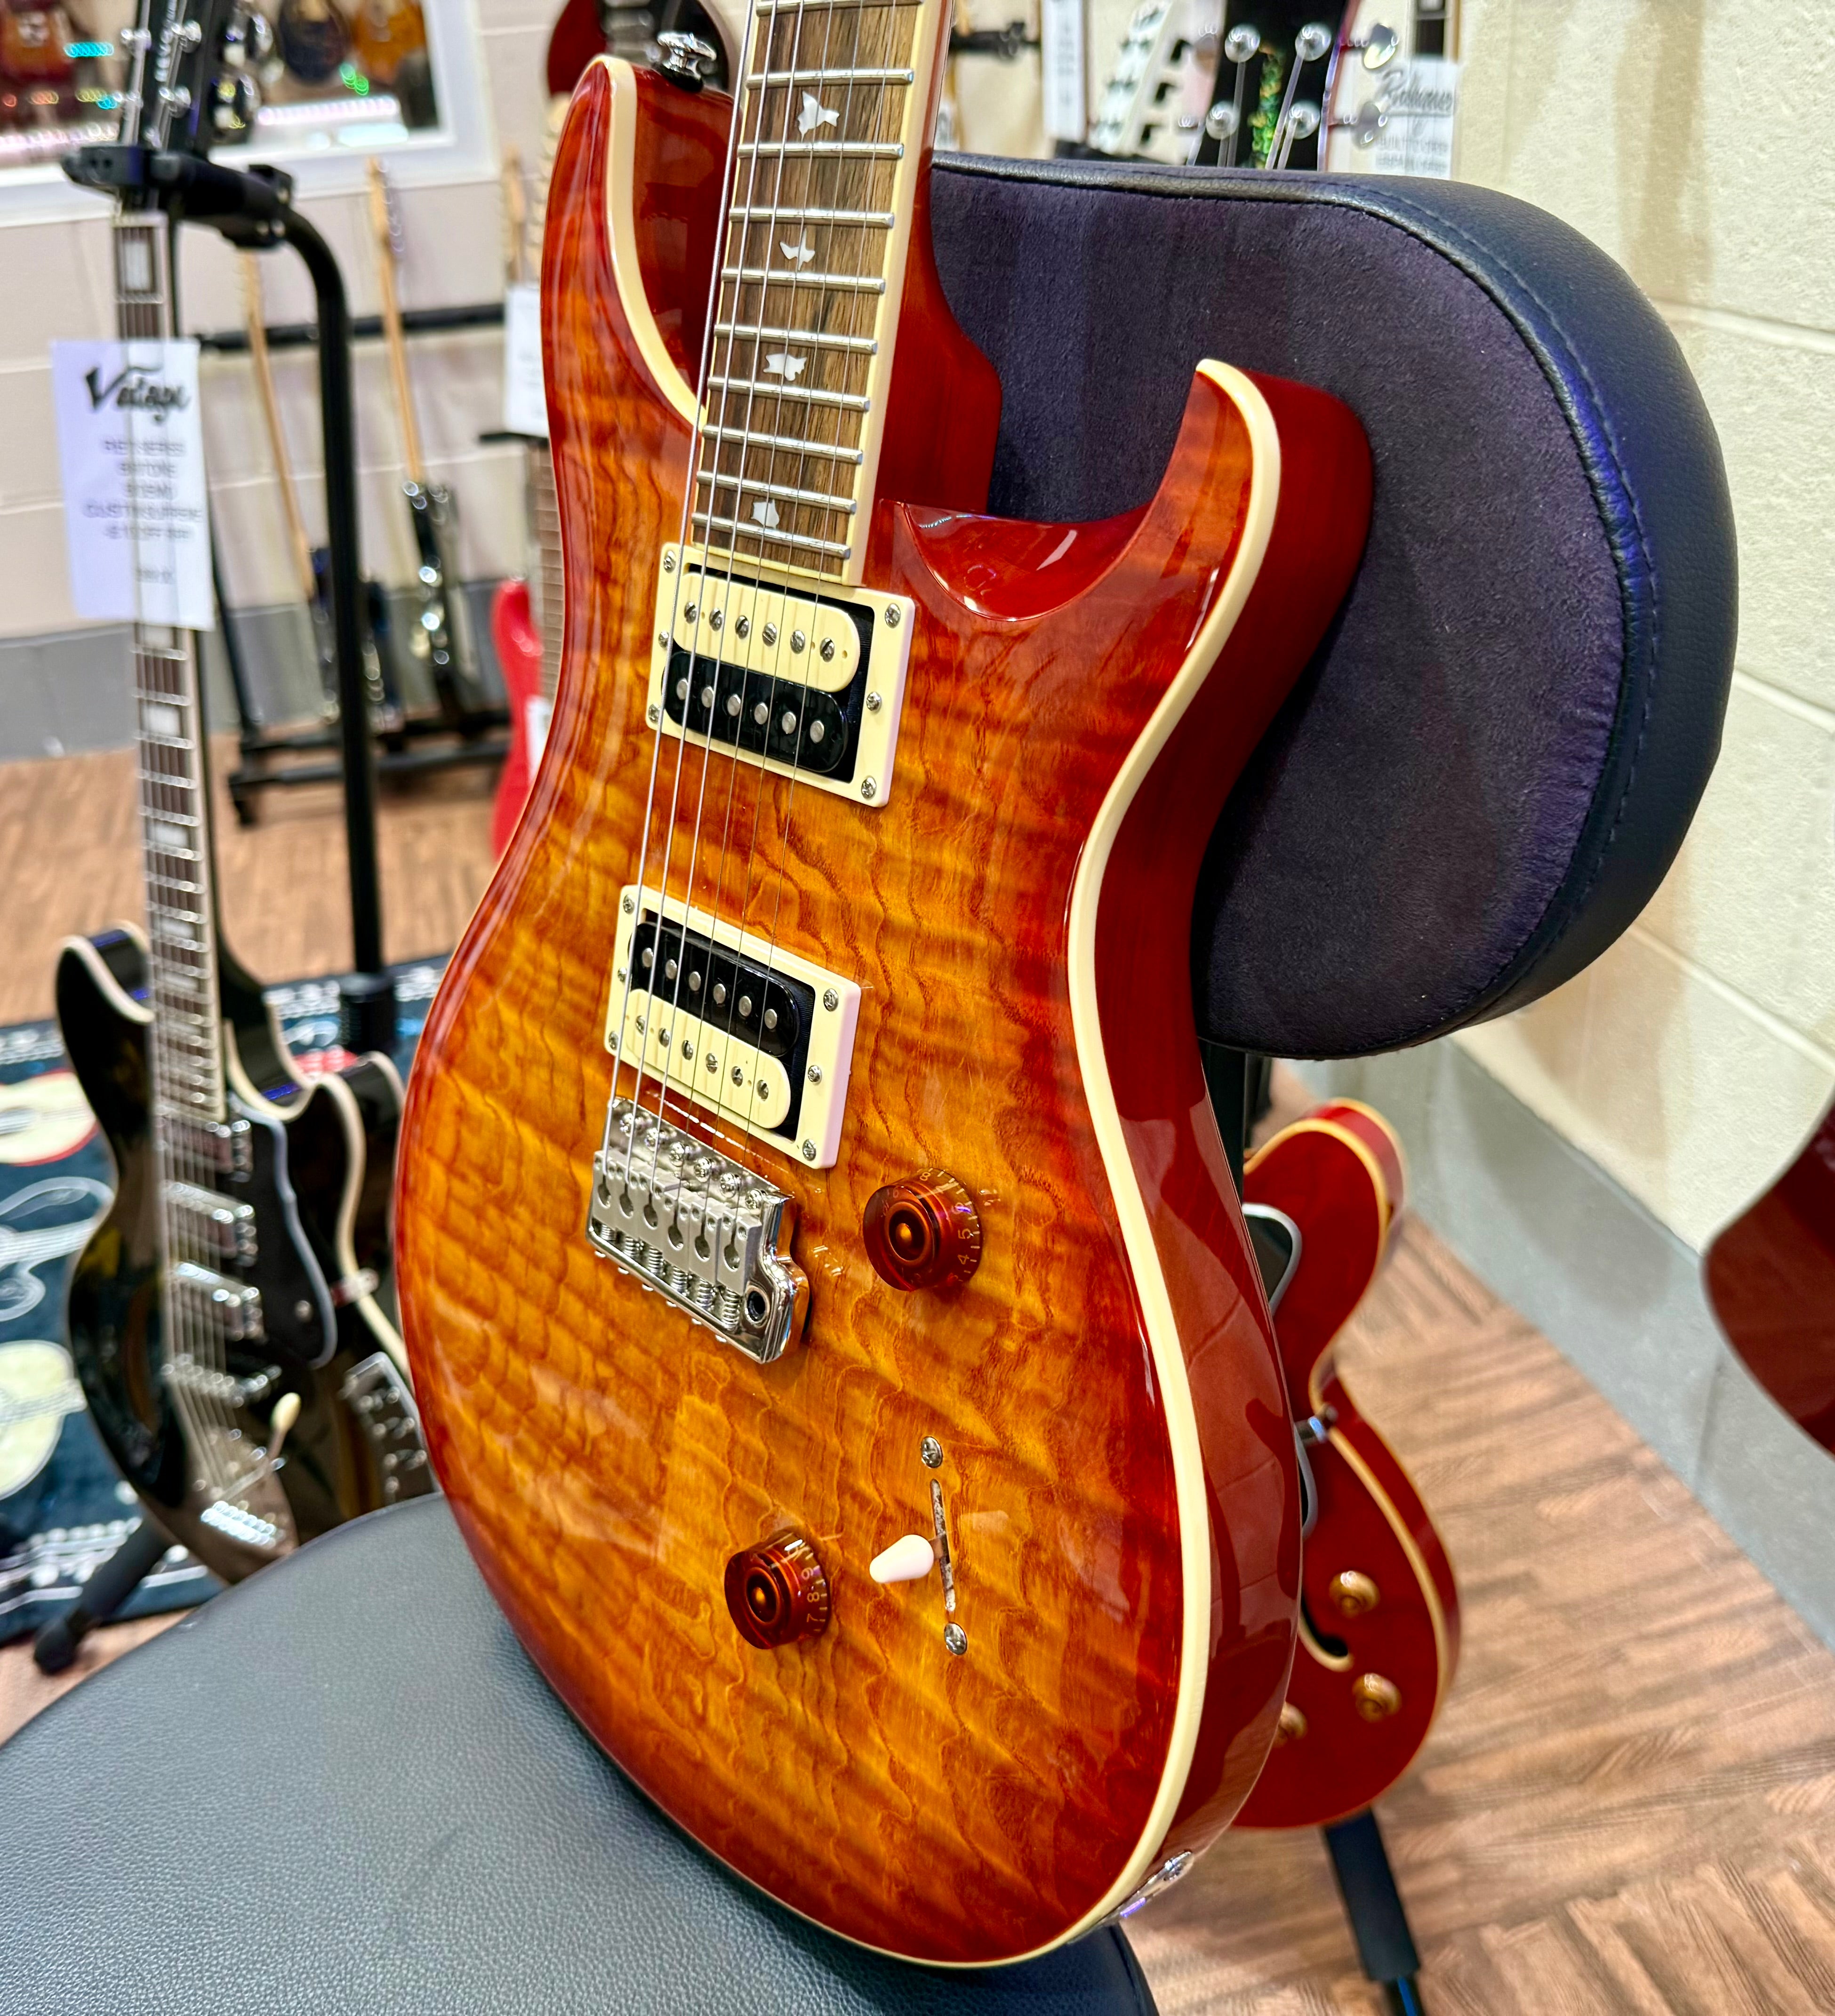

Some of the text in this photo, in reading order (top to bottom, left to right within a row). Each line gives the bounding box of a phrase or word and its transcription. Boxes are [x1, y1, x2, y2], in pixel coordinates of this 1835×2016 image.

[919, 1172, 931, 1181] 8
[957, 1228, 971, 1240] 5
[957, 1254, 970, 1265] 4
[801, 1567, 813, 1580] 9
[807, 1592, 820, 1603] 8
[807, 1613, 818, 1623] 7
